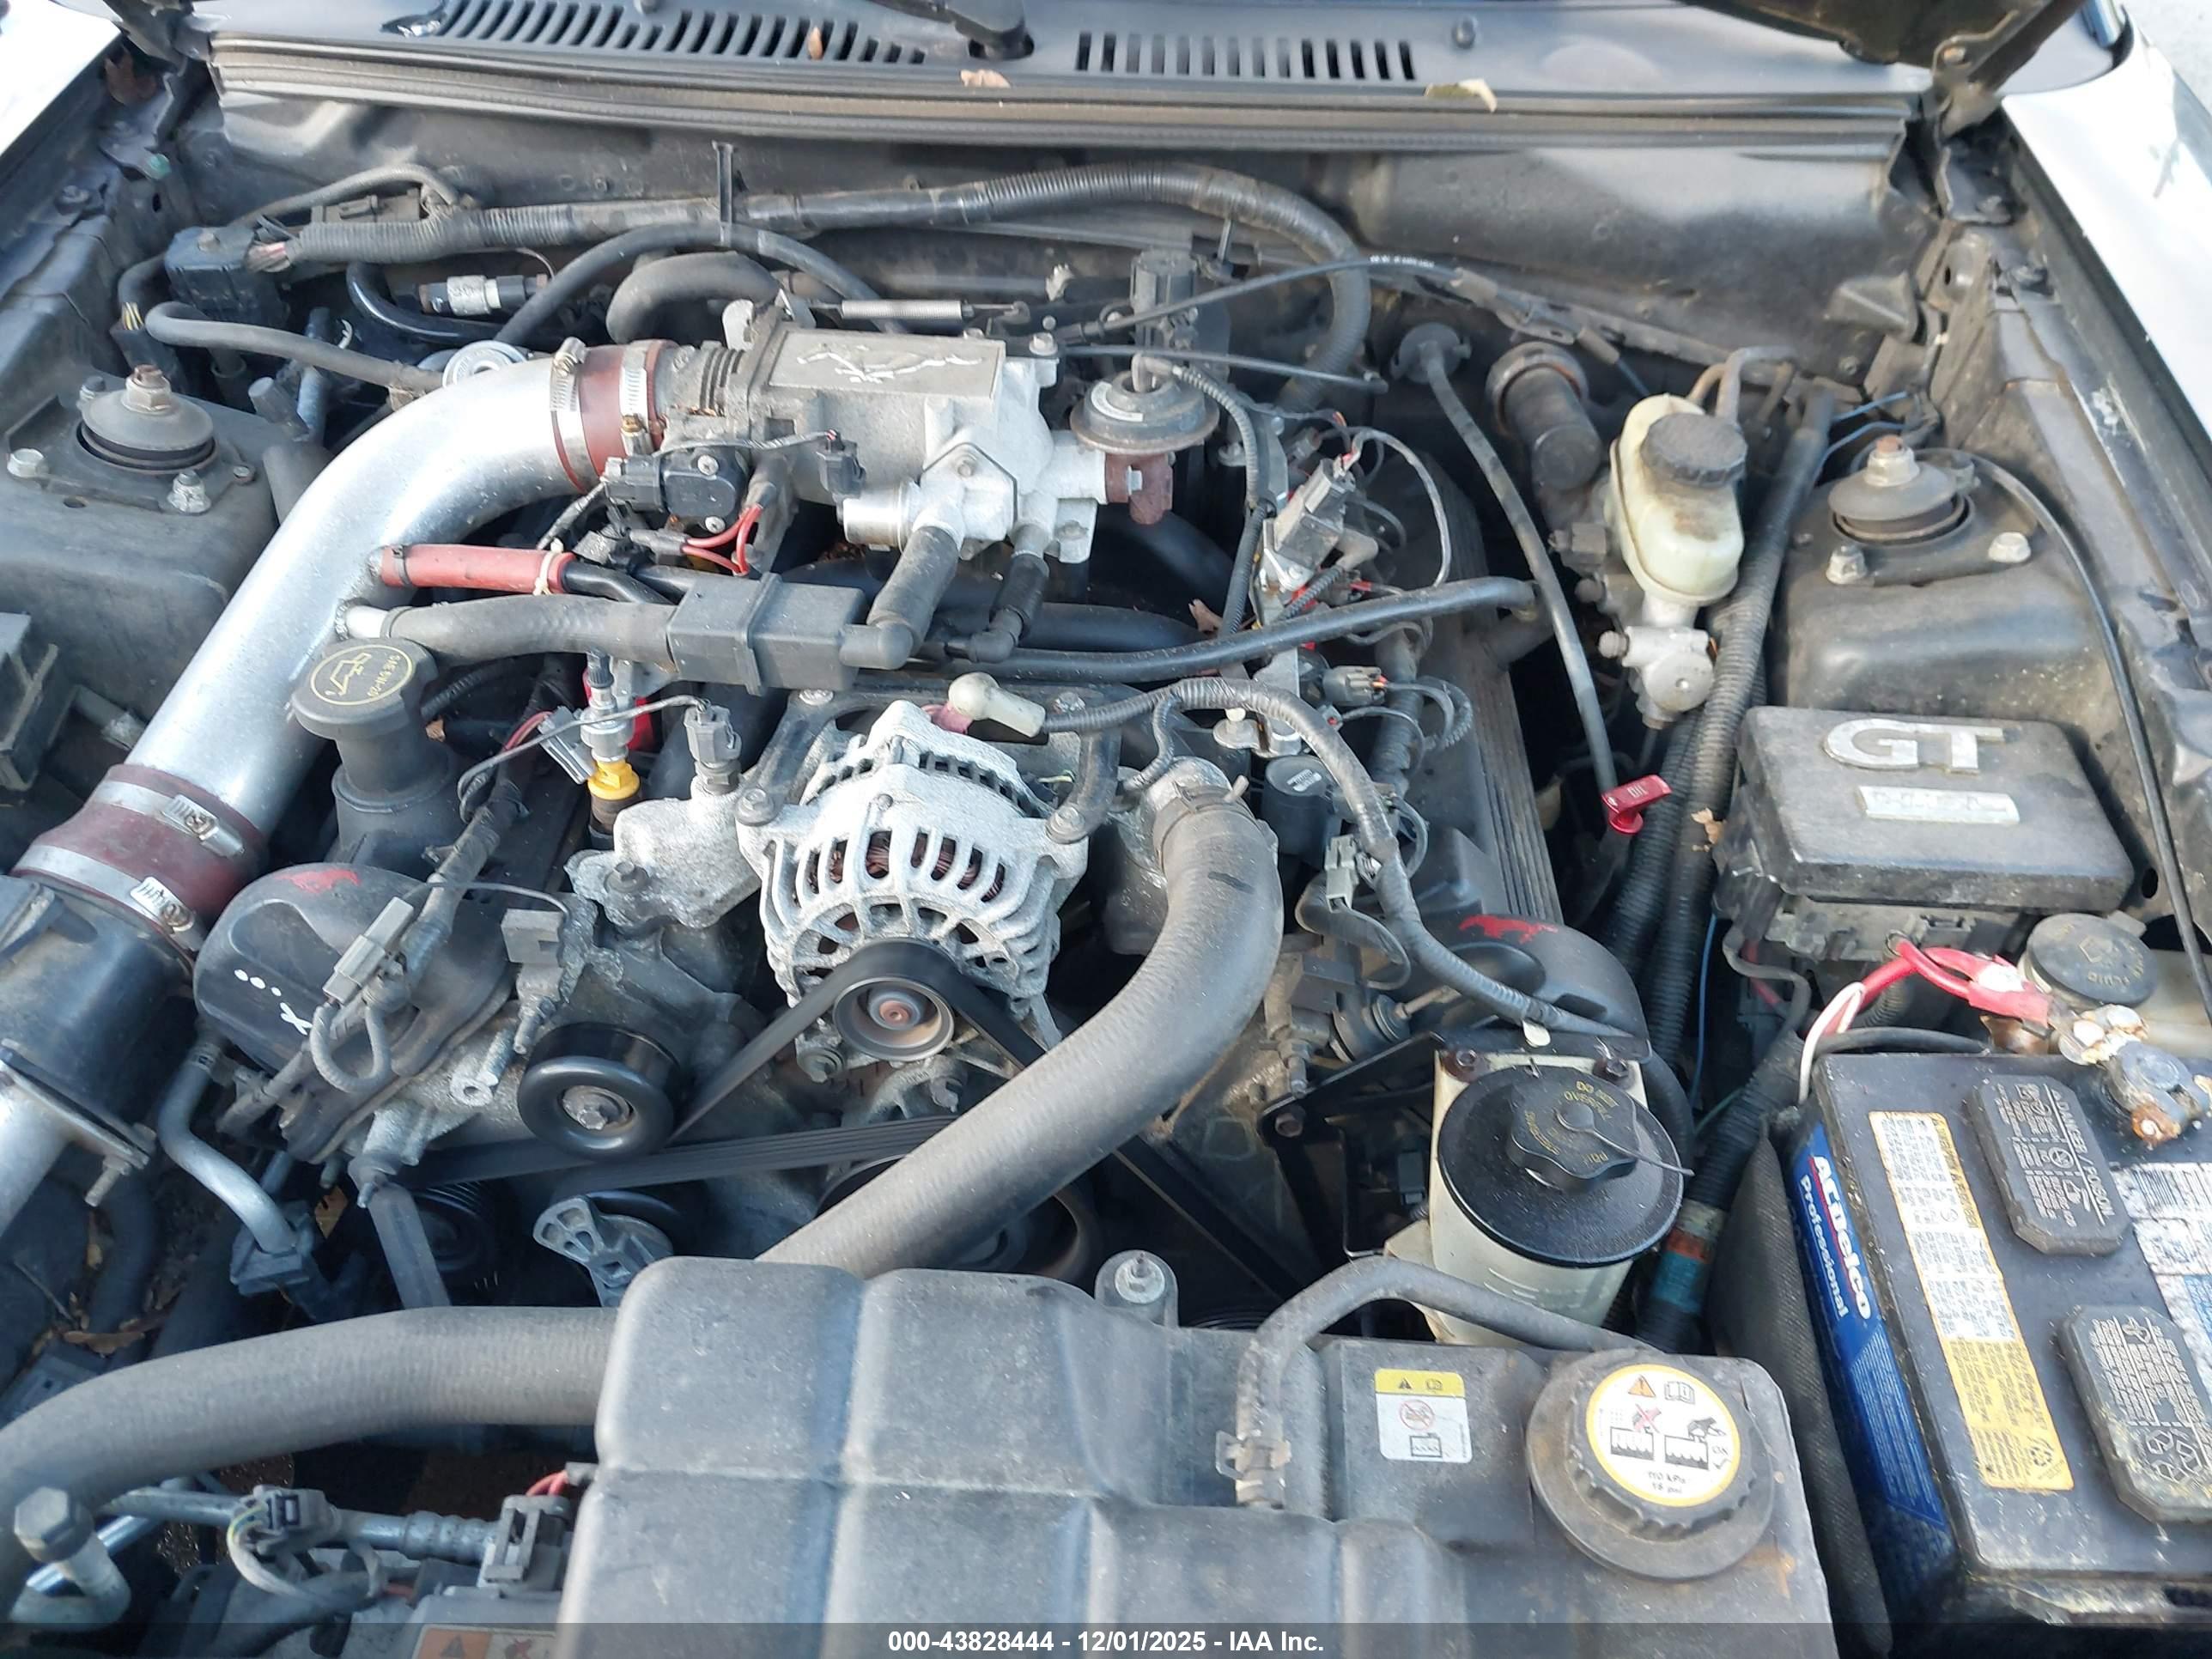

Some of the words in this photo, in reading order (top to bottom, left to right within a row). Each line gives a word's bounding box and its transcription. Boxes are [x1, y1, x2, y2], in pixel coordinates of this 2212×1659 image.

[1626, 783, 1649, 799] OIL
[1823, 718, 2007, 775] GT
[2057, 1100, 2088, 1154] DANGER
[2081, 1164, 2116, 1217] POISON
[1800, 1174, 1850, 1318] Professional
[1812, 1156, 1872, 1320] ACDelco
